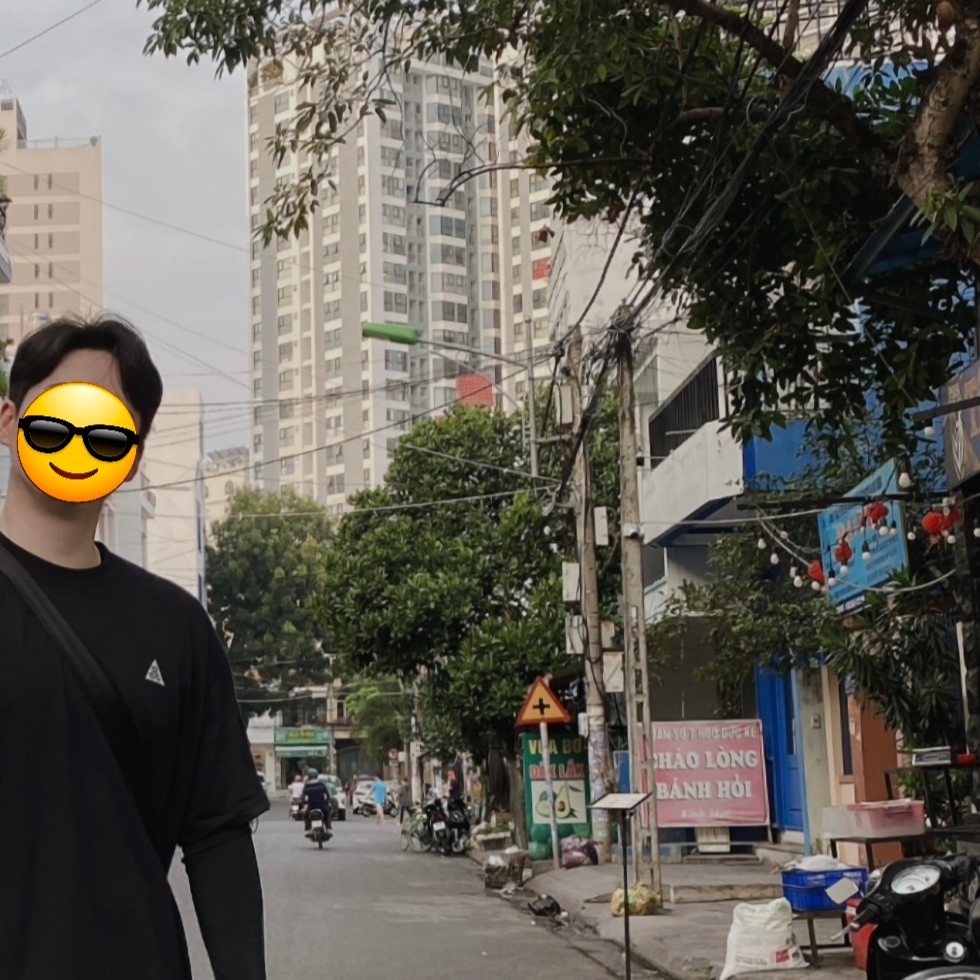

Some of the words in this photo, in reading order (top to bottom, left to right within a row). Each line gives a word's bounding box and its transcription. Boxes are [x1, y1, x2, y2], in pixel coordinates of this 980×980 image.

[705, 745, 759, 769] LÒNG
[656, 777, 711, 800] BÁNH
[716, 774, 752, 799] HỎI
